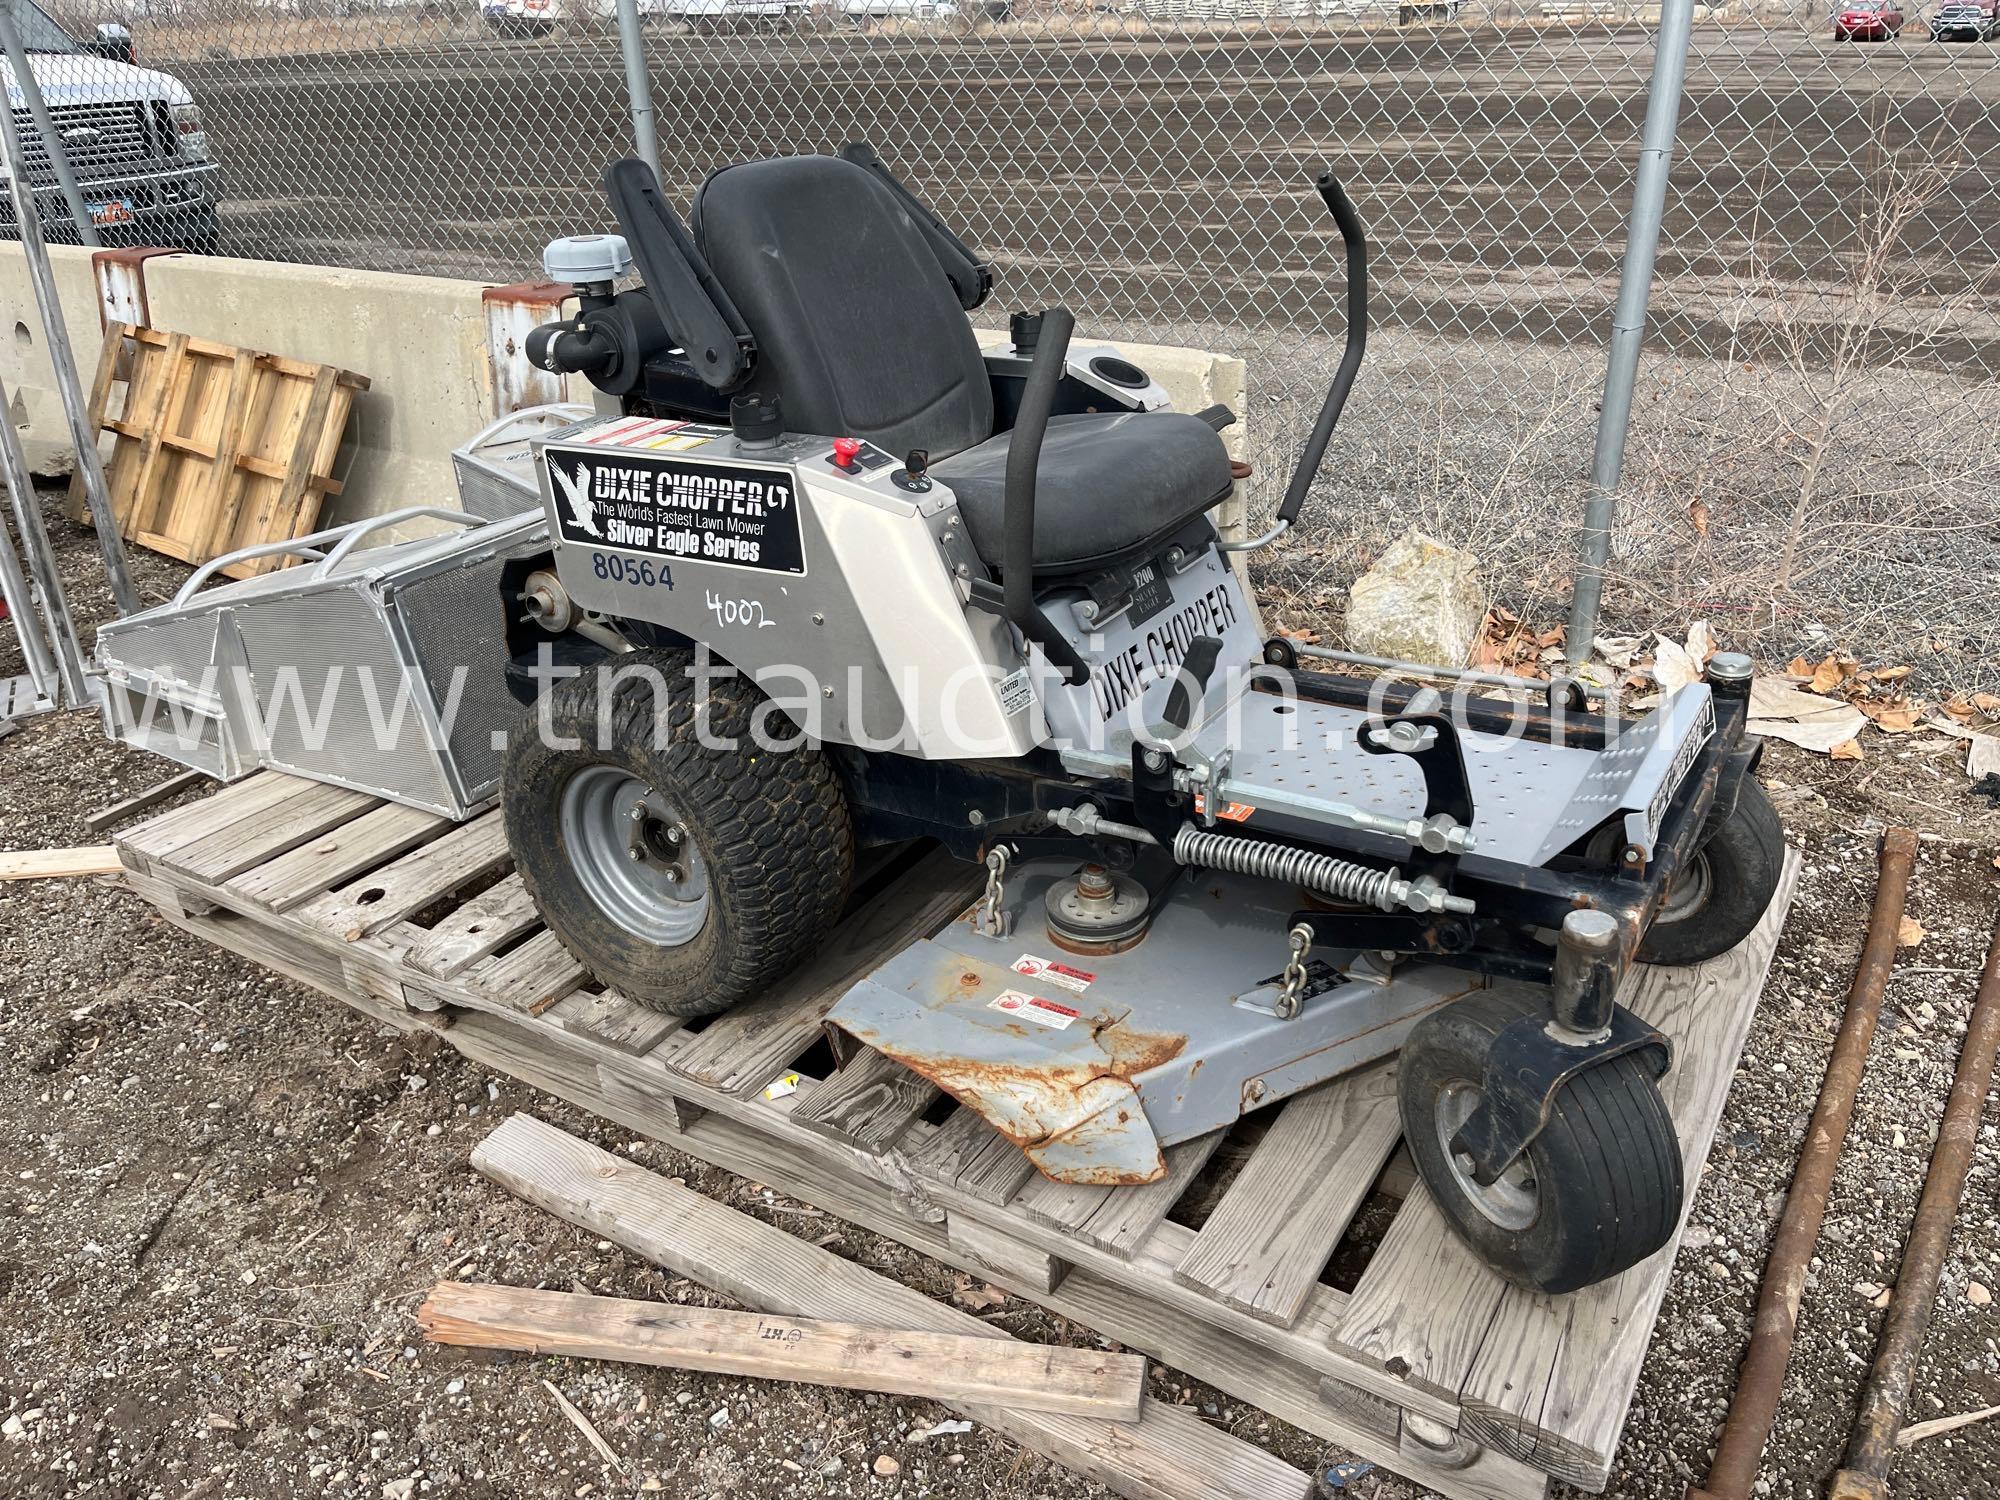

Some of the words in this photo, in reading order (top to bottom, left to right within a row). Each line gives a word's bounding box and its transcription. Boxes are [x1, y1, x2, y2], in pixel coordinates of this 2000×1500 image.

[595, 466, 652, 504] DIXIE
[596, 500, 616, 517] The
[618, 502, 654, 522] World's
[656, 507, 693, 527] Fastest
[696, 511, 724, 530] Lawn
[727, 516, 765, 536] Mower
[607, 518, 654, 547] Silver
[657, 524, 700, 556] Eagle
[703, 532, 761, 562] Series
[592, 552, 675, 592] 80564
[705, 588, 777, 629] 4002
[1089, 643, 1151, 723] DIXIE
[1146, 584, 1237, 680] CHOPPER
[1000, 679, 1018, 695] UNITED
